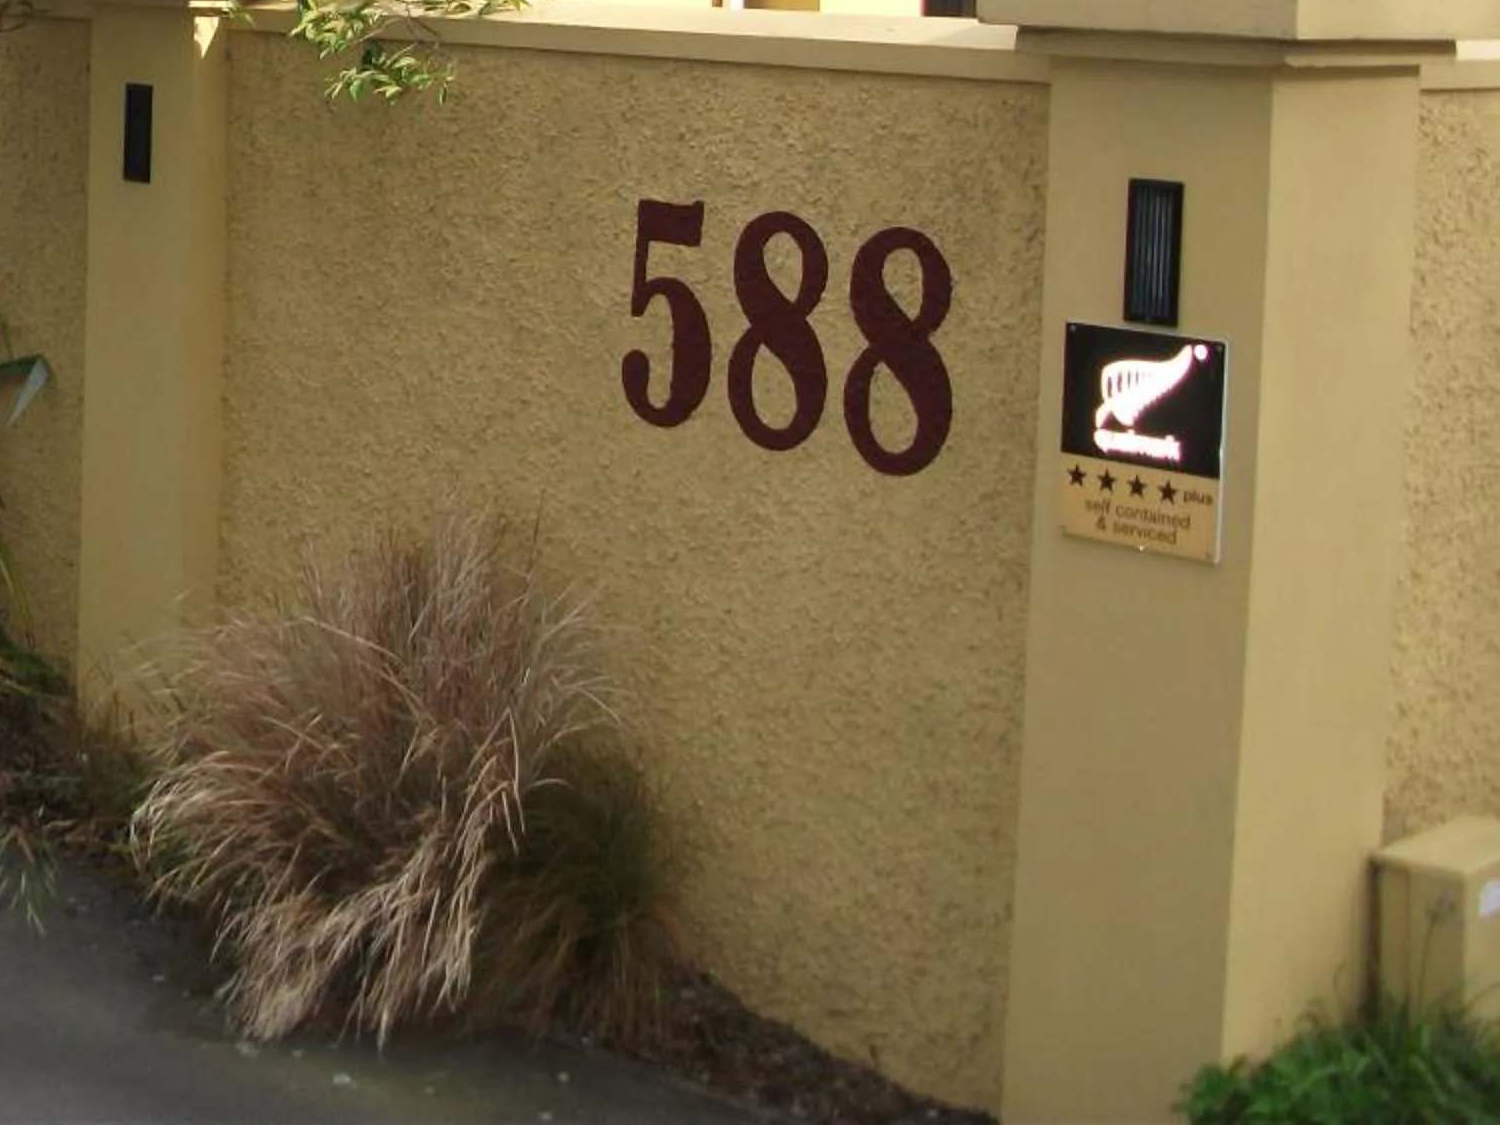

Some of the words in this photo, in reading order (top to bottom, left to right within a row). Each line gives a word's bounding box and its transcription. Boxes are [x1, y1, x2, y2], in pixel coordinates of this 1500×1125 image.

[622, 199, 953, 476] 588
[1183, 490, 1214, 506] plus
[1115, 504, 1191, 529] contained
[1113, 520, 1177, 545] serviced
